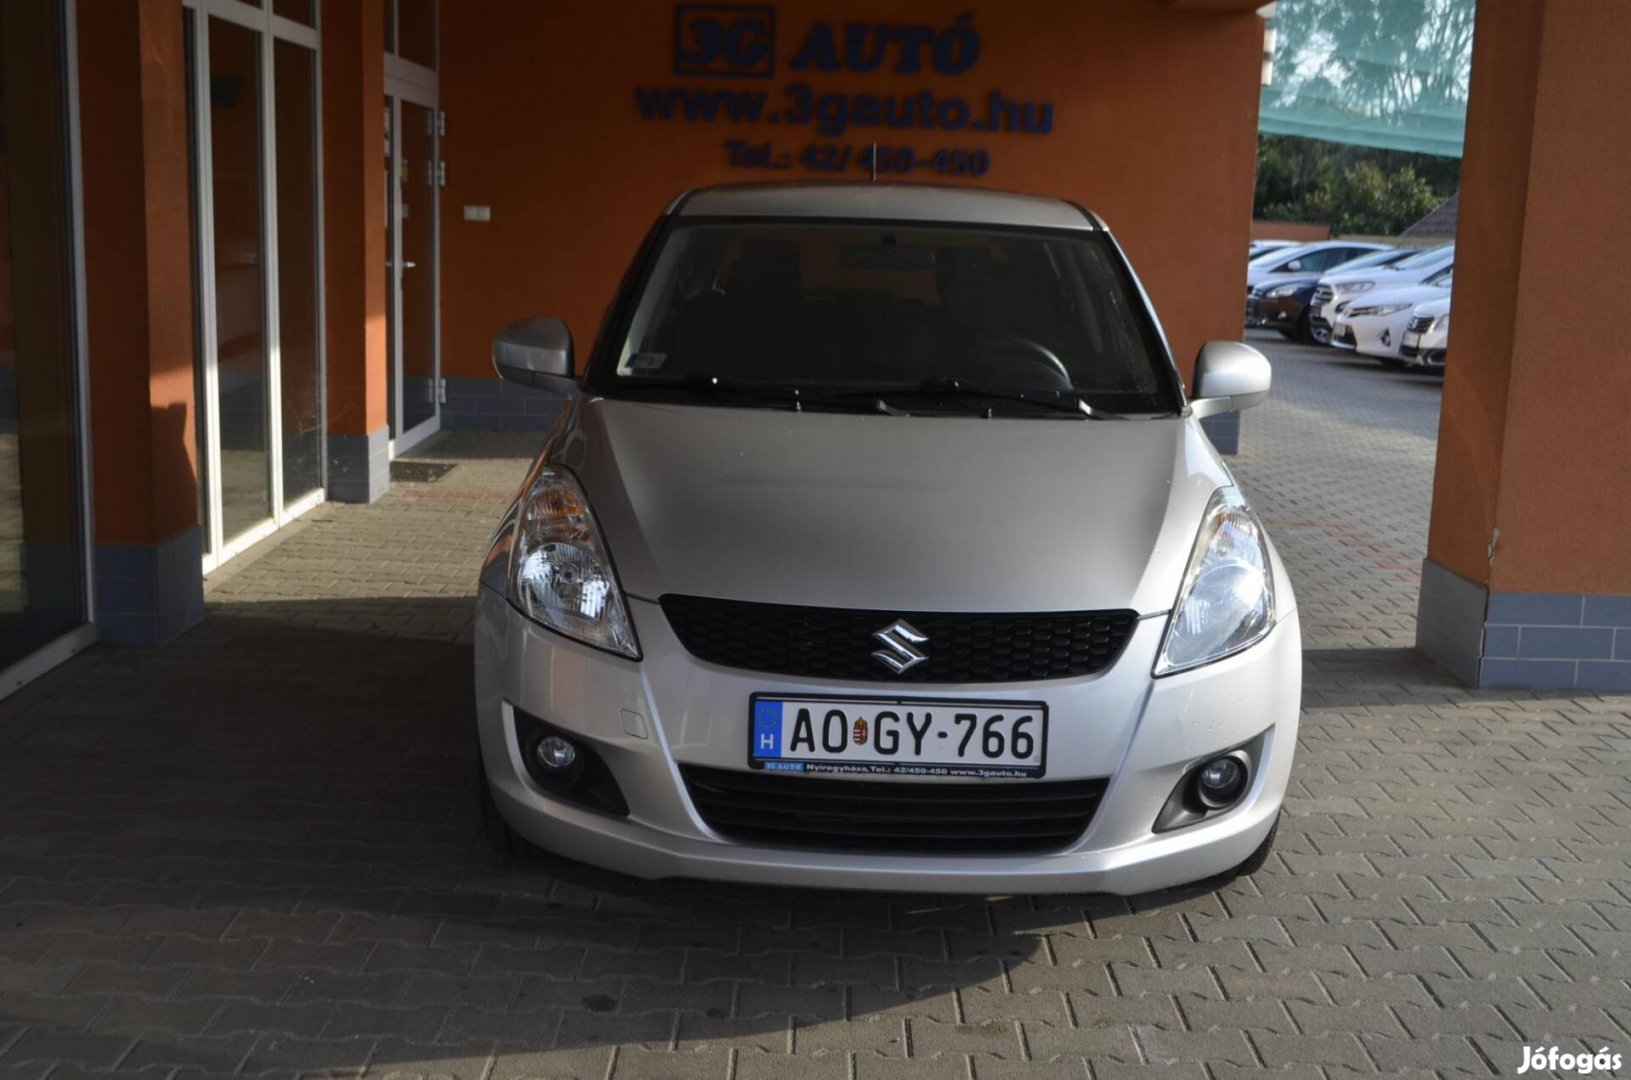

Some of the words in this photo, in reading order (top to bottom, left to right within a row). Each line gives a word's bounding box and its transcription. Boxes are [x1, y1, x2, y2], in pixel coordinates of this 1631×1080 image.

[688, 17, 768, 67] 3G
[790, 13, 981, 74] AUTÓ
[635, 84, 1054, 136] www.3gauto.hu
[760, 733, 774, 750] H
[789, 707, 848, 754] AO
[873, 710, 1034, 760] GY-766
[950, 768, 1028, 778] www.3gauto.hu
